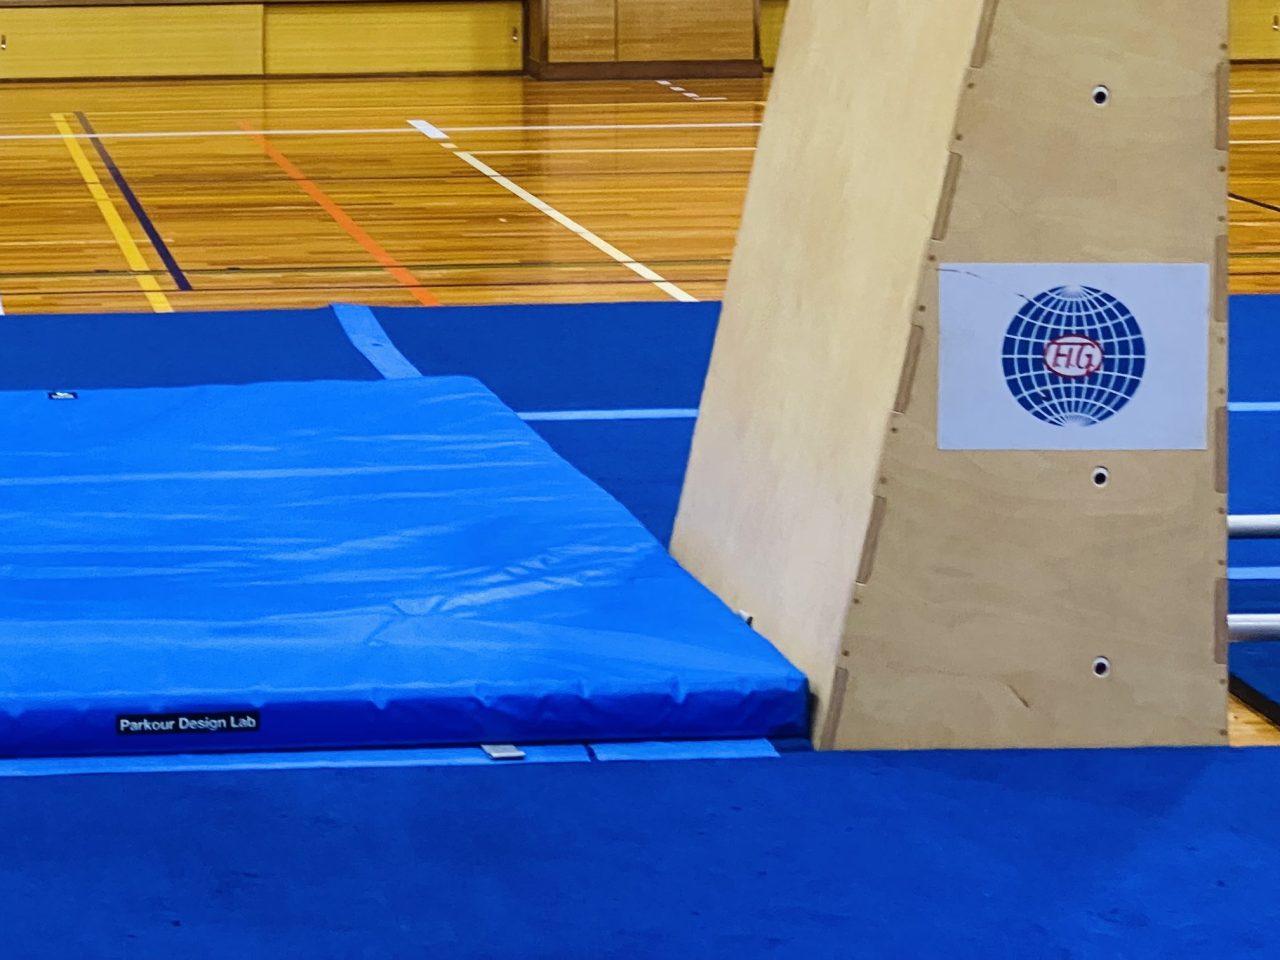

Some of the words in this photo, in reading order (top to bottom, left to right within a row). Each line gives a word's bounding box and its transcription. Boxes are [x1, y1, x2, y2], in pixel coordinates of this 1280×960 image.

[120, 719, 175, 731] Parkour
[178, 716, 226, 731] Design
[230, 715, 256, 728] Lab
